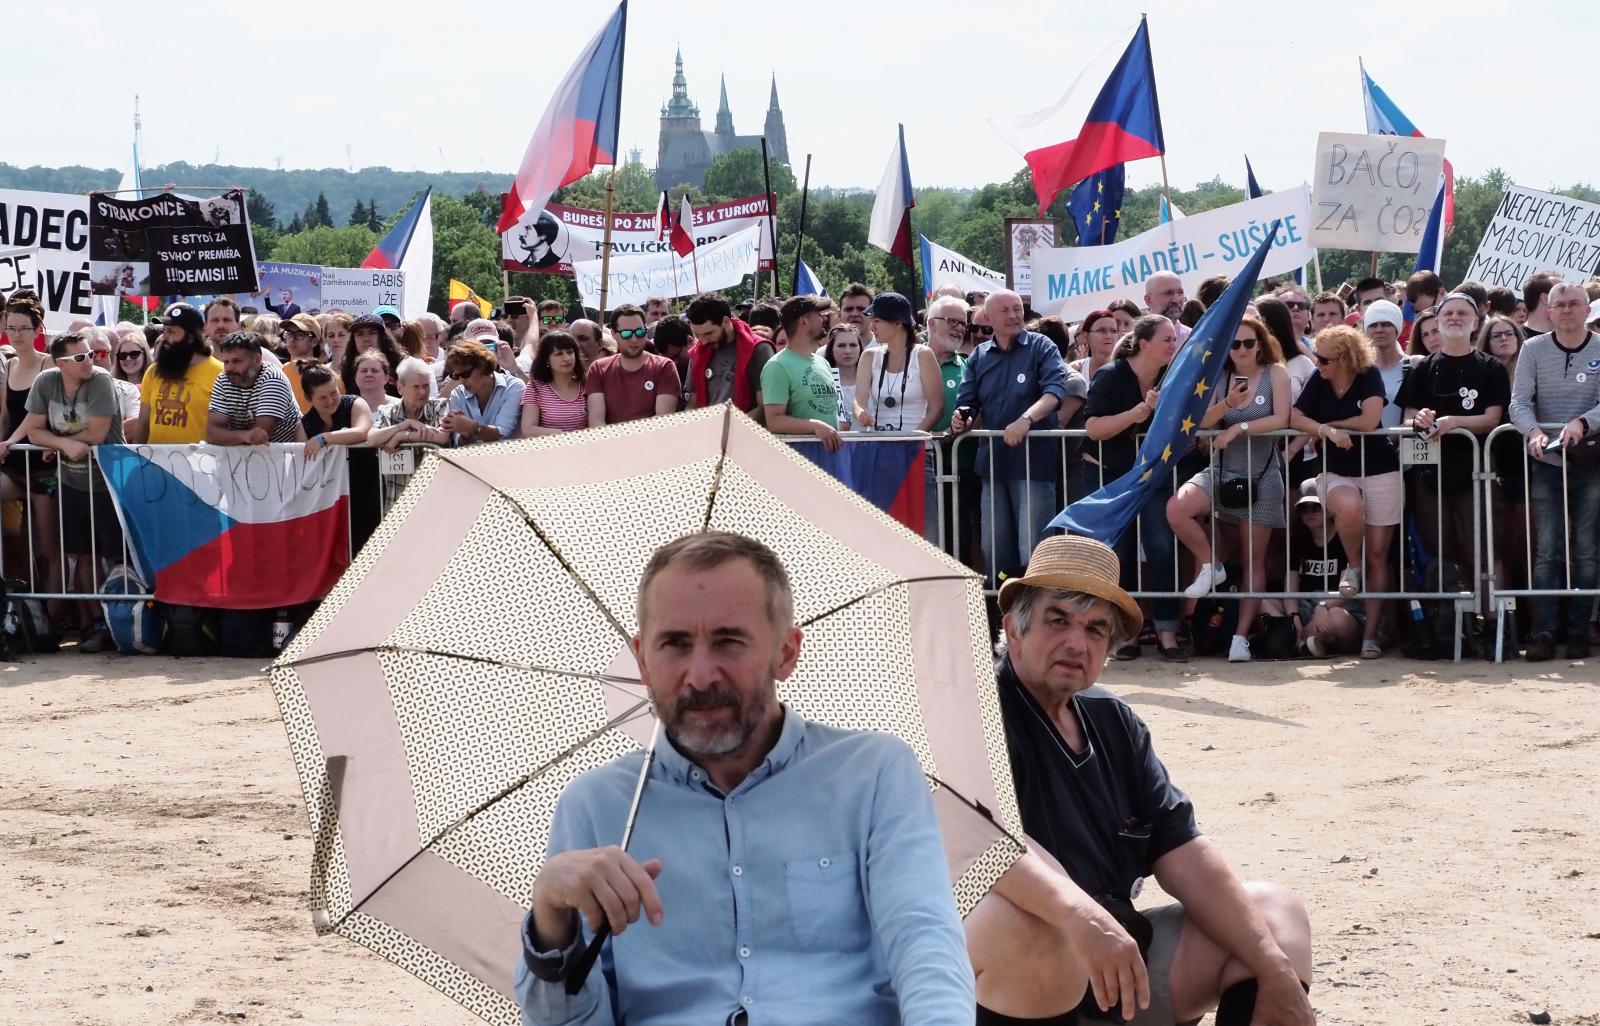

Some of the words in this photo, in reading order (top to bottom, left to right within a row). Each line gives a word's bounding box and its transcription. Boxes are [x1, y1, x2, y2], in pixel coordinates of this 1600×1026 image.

[1329, 141, 1421, 195] BAČO,
[615, 219, 629, 229] PO
[707, 212, 715, 222] K
[1315, 201, 1359, 232] ZA
[216, 233, 226, 242] ZA
[1483, 222, 1561, 262] MASOVÍ
[322, 279, 371, 287] zaměstnanec
[372, 272, 403, 288] BABIŠ
[939, 259, 965, 273] ANI
[1048, 265, 1115, 300] MÁME
[1121, 242, 1199, 287] NADĚJI
[1468, 253, 1537, 291] MAKAL
[38, 262, 92, 315] VÉ
[322, 299, 329, 307] je
